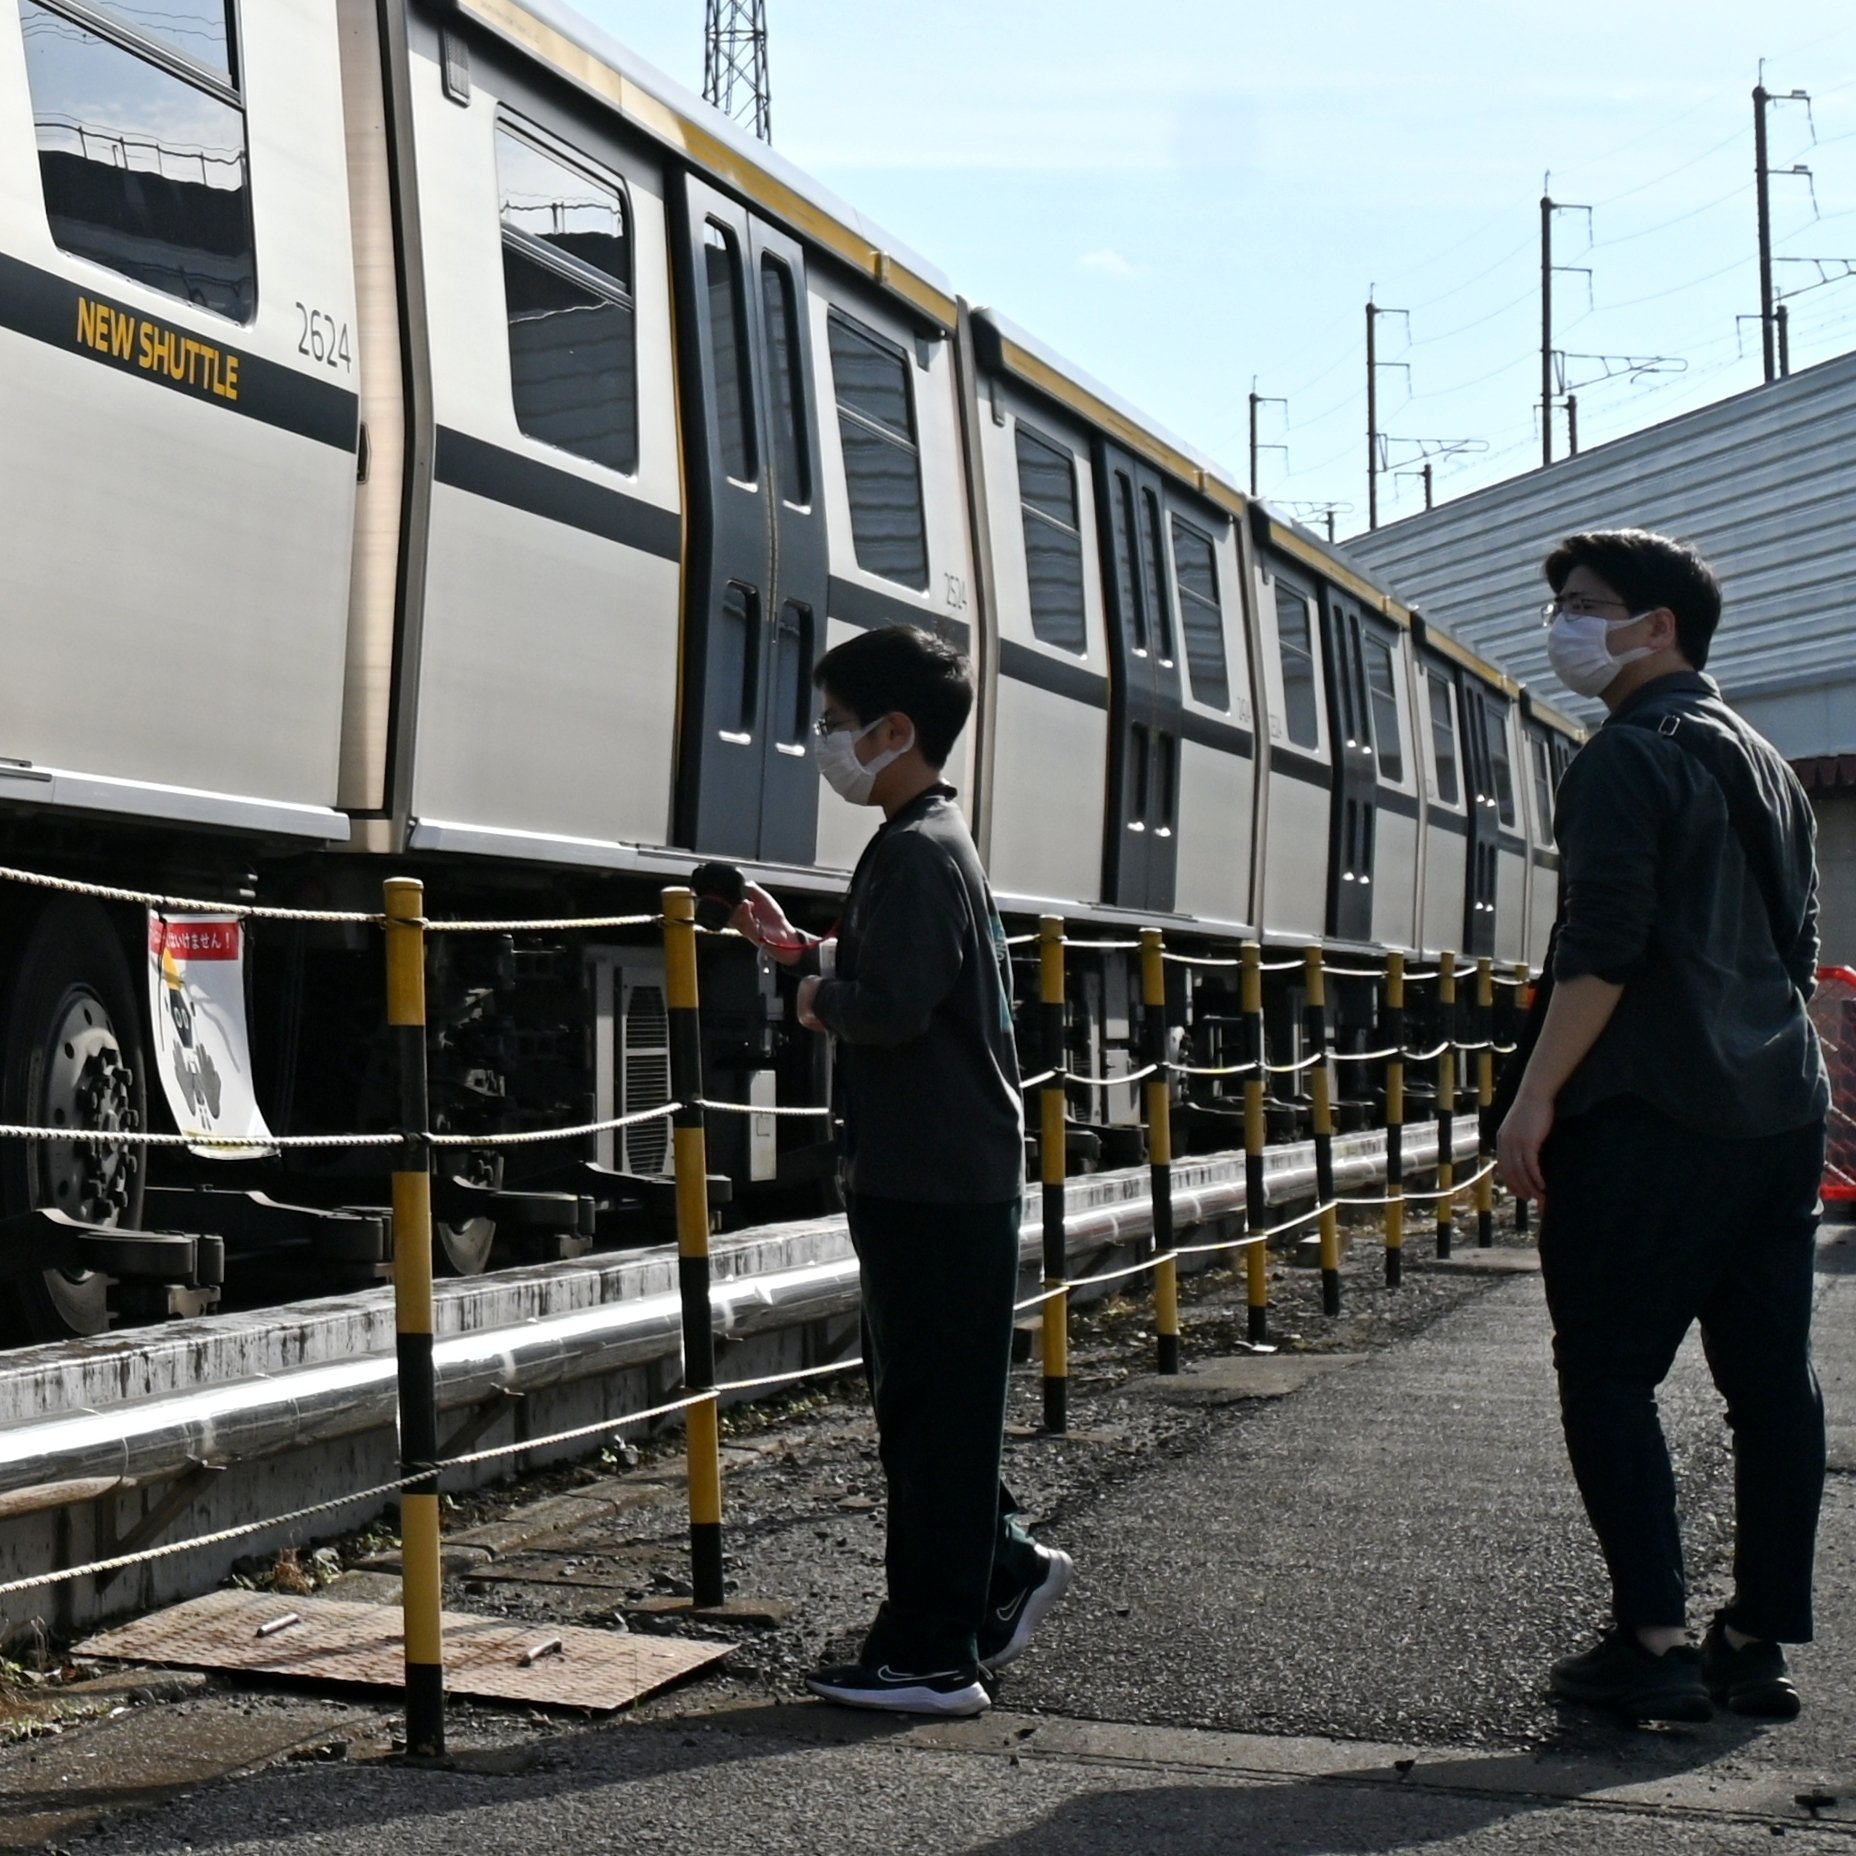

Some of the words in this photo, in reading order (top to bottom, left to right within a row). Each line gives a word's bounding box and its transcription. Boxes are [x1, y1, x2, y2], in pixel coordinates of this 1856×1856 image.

[76, 296, 135, 361] NEW
[138, 320, 239, 401] SHUTTLE
[295, 301, 352, 375] 2624
